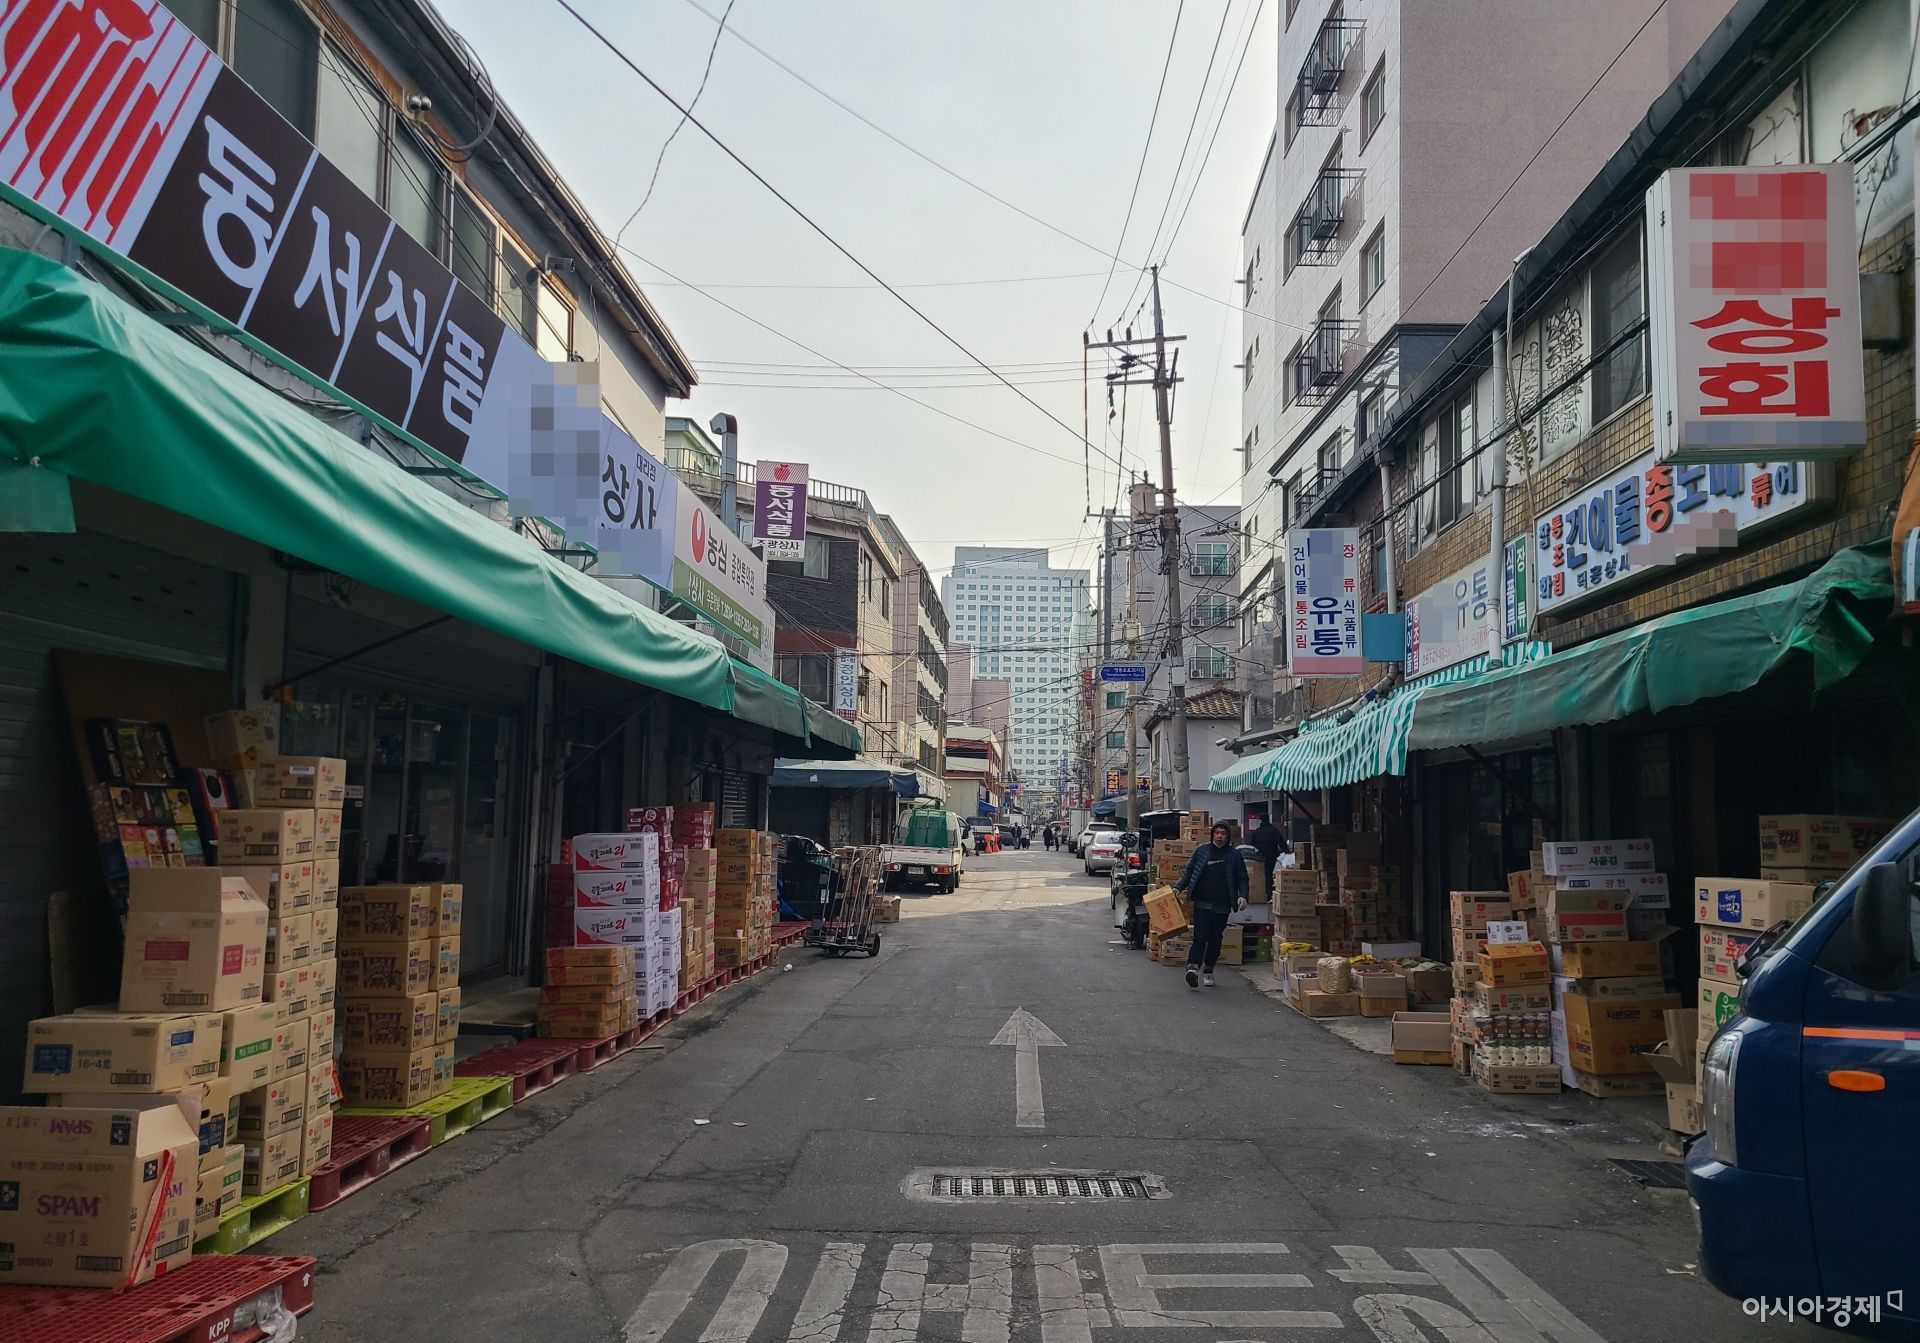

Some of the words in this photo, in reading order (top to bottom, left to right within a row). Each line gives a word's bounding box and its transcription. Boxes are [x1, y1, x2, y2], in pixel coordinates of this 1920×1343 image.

[198, 115, 486, 433] 동서식품
[1689, 297, 1840, 417] 상회
[636, 452, 657, 483] 대리점
[765, 484, 796, 537] 동서식품
[707, 527, 728, 575] 농심
[756, 539, 800, 551] 조광상사
[1551, 513, 1565, 597] 통조림
[1293, 547, 1308, 595] 건어물
[1455, 567, 1489, 631] 유통
[1295, 600, 1308, 649] 통조림
[1310, 596, 1344, 656] 유통
[1344, 600, 1357, 649] 식품류
[1710, 934, 1724, 946] 농심
[48, 1118, 93, 1135] SPAM
[37, 1194, 101, 1218] SPAM
[208, 1317, 230, 1341] KPP
